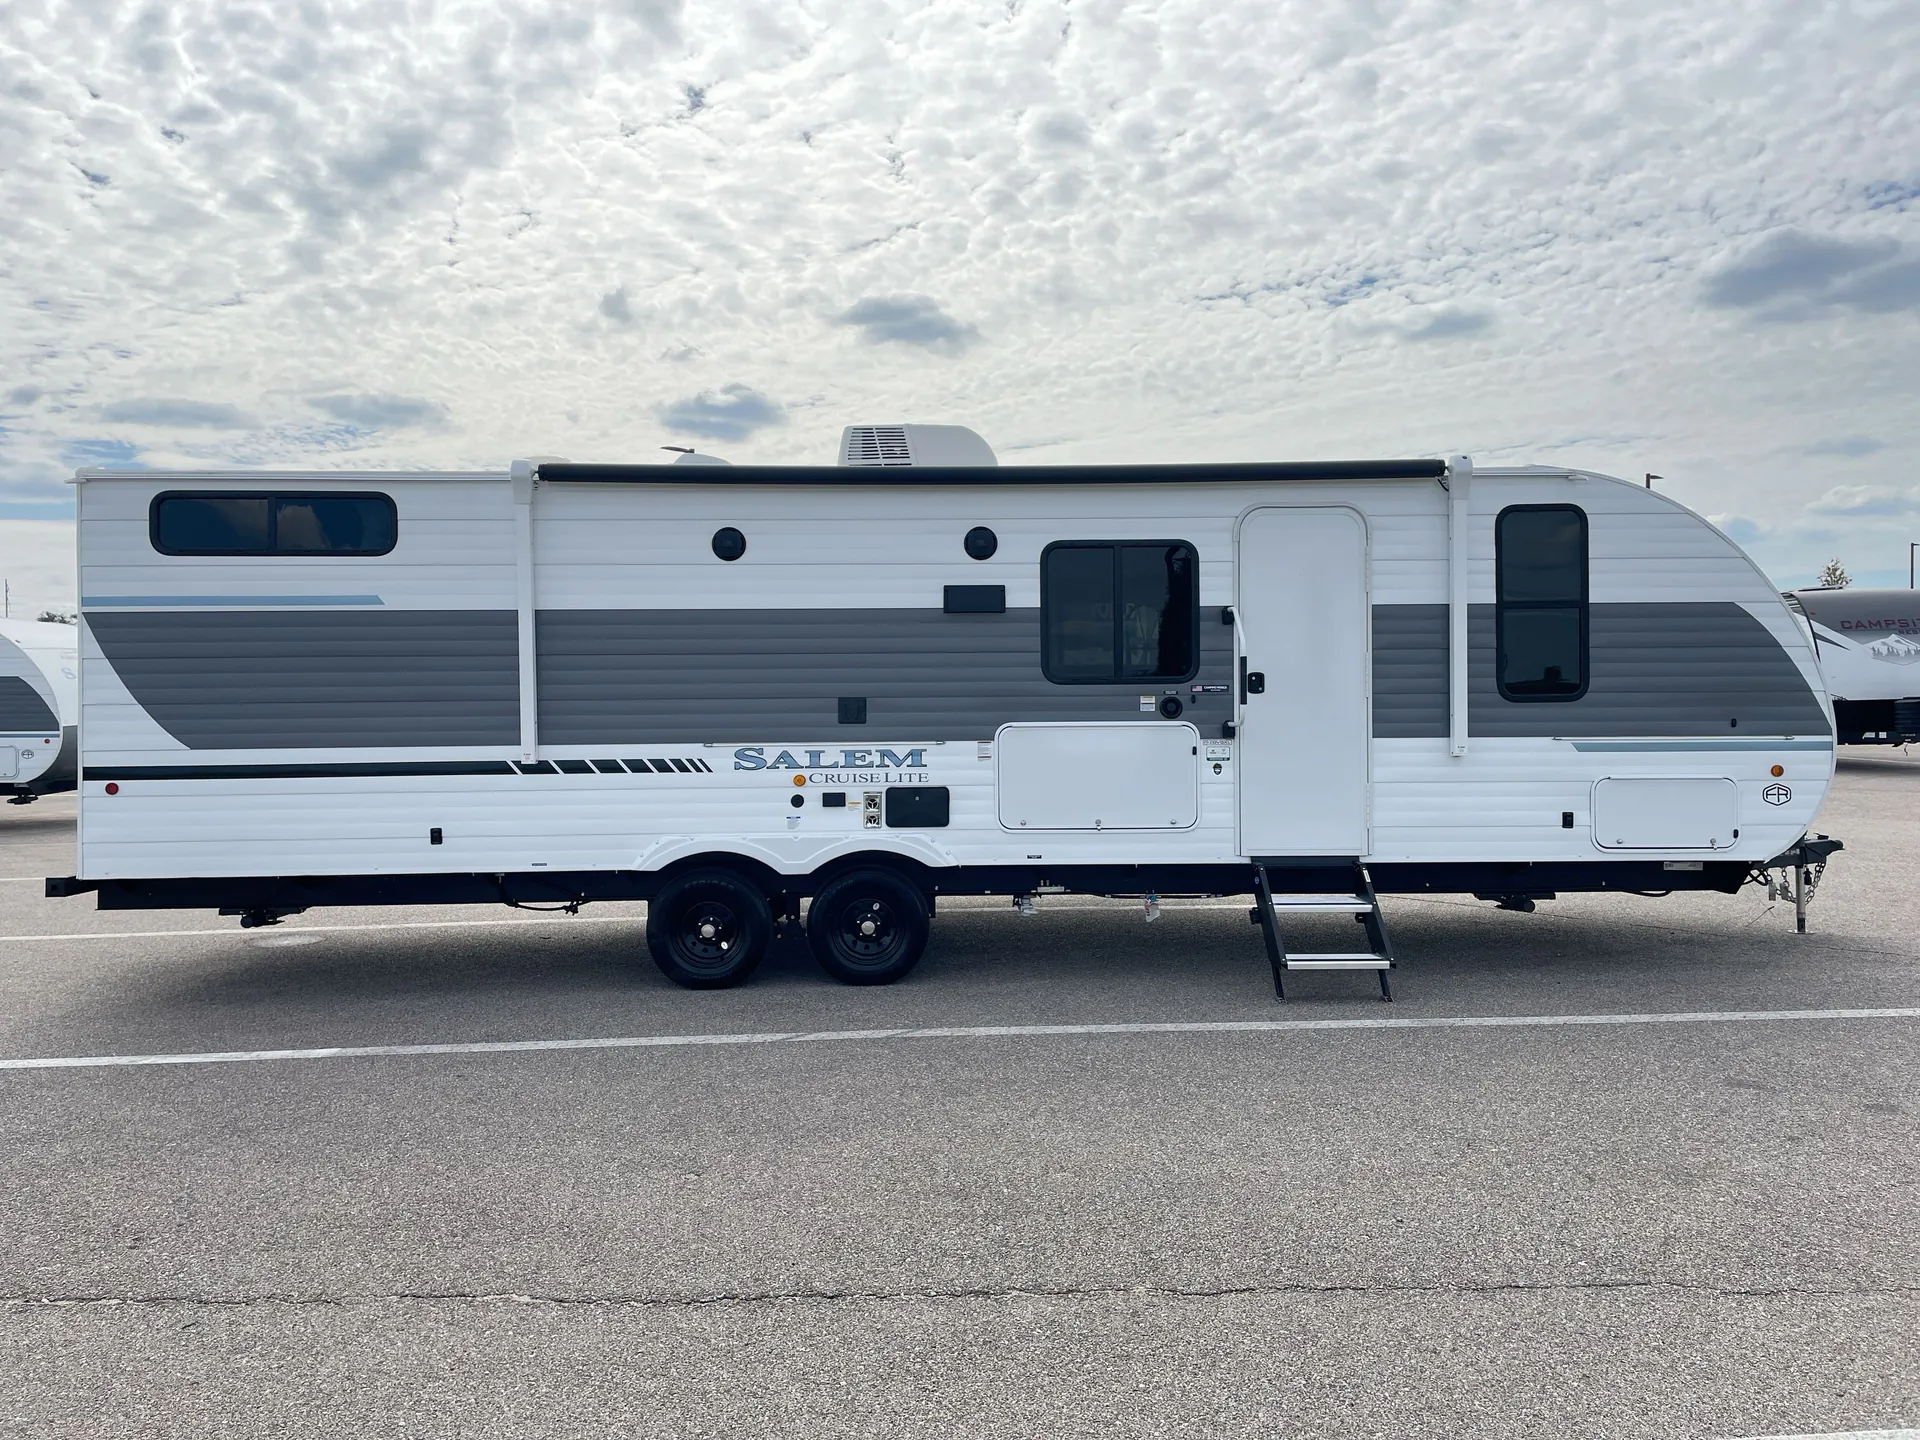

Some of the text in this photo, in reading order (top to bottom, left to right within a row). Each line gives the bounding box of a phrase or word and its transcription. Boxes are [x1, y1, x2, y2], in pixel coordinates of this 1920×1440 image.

[734, 748, 928, 770] SALEM
[808, 771, 930, 784] CRUISE LITE
